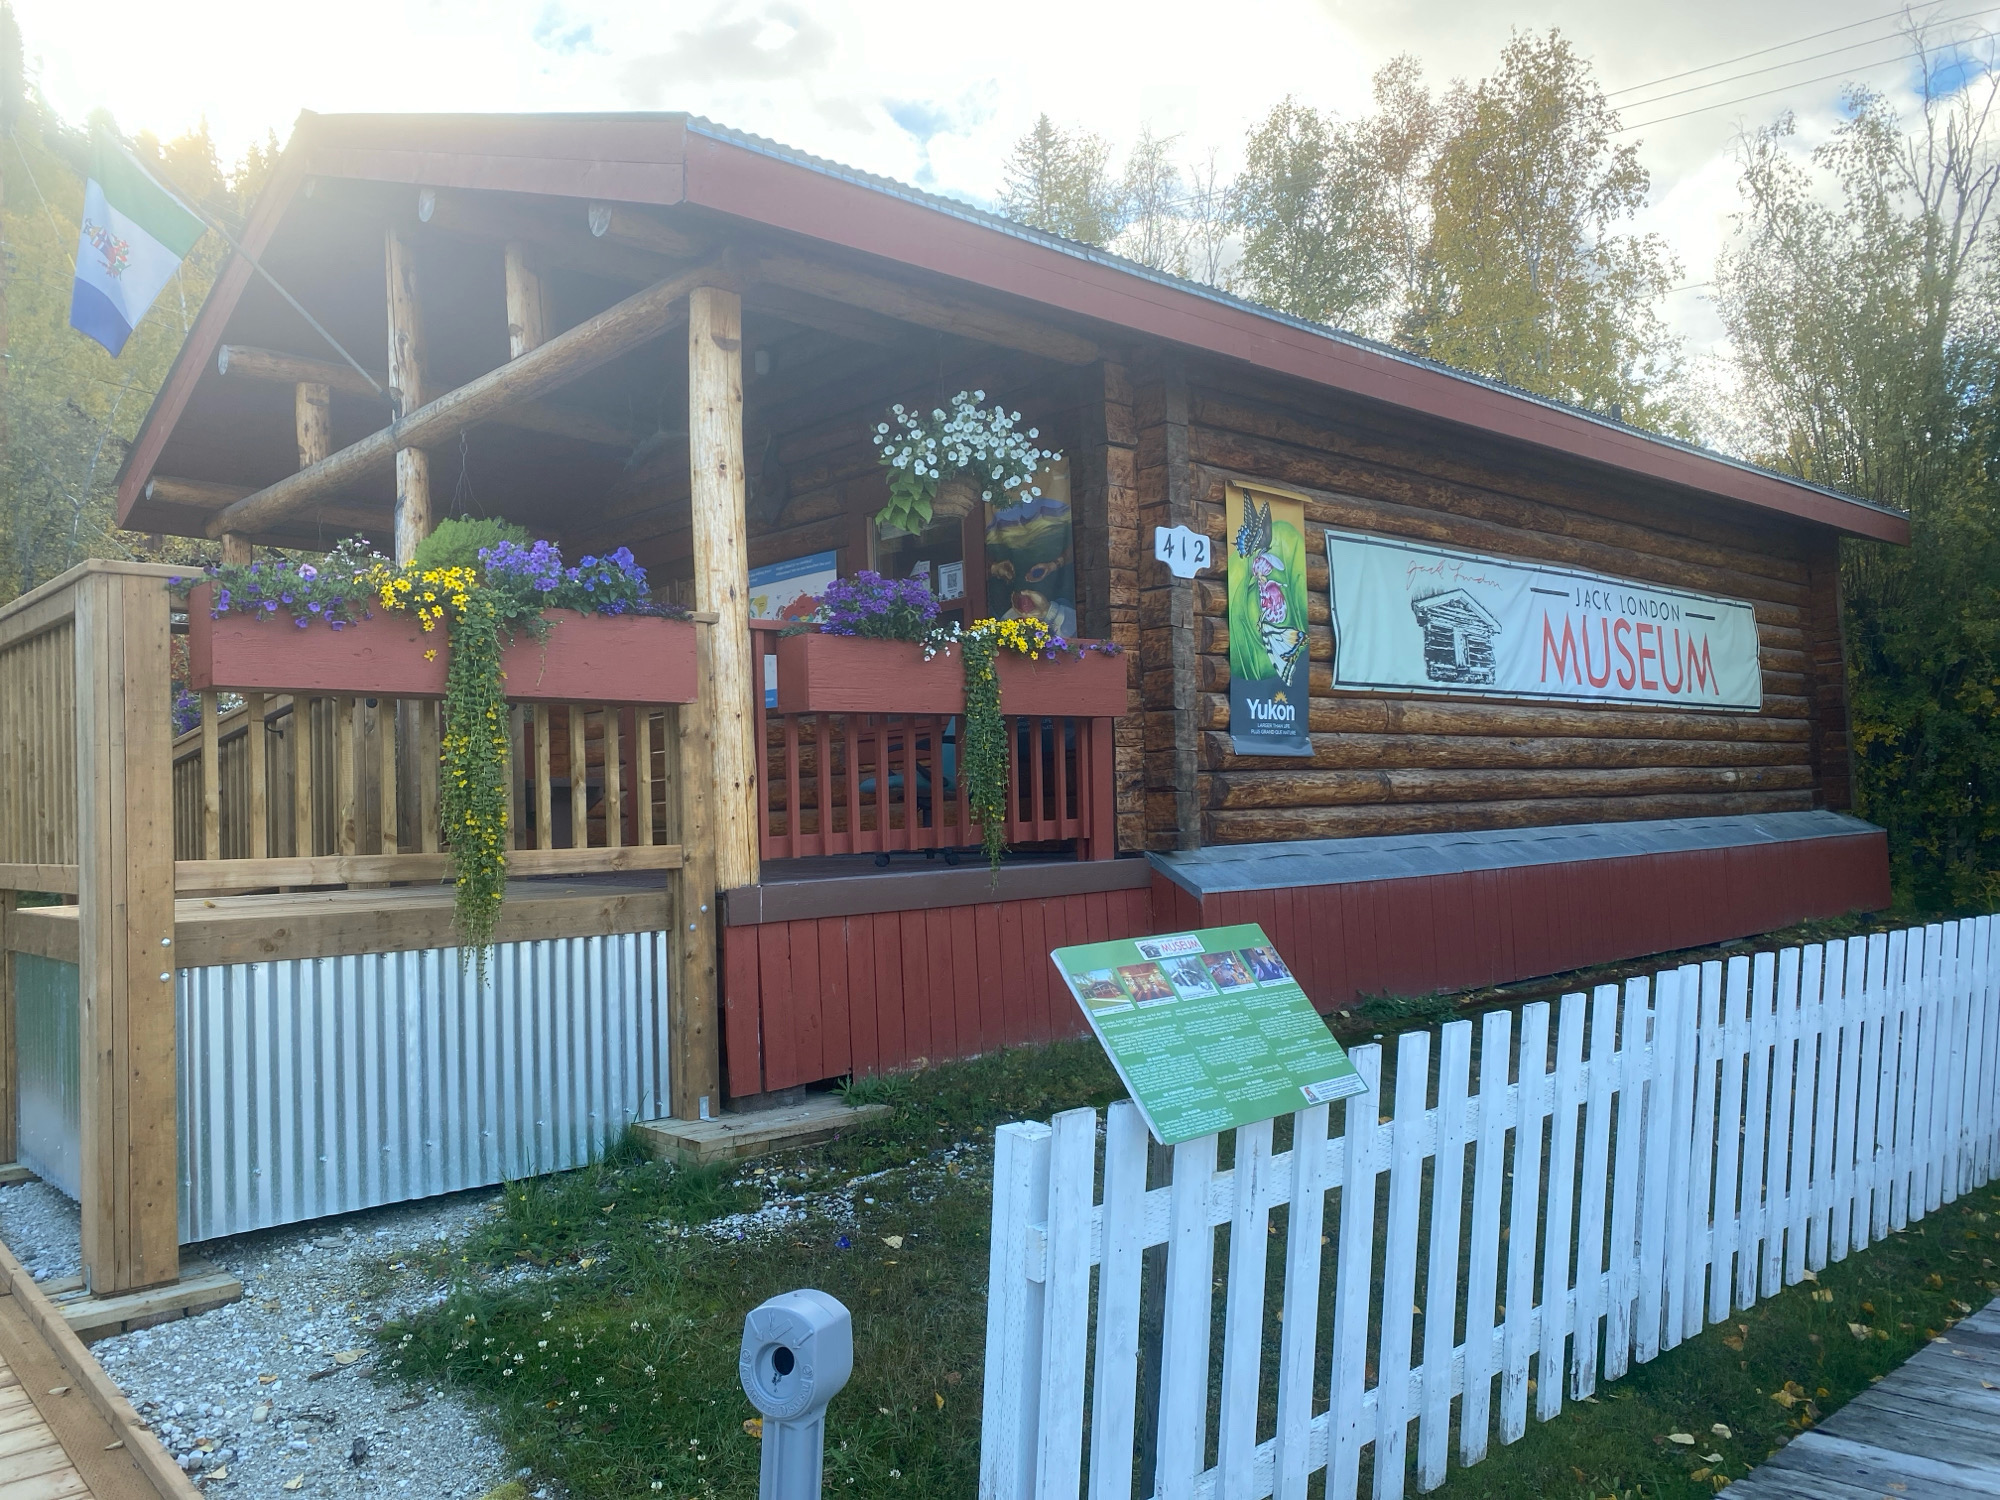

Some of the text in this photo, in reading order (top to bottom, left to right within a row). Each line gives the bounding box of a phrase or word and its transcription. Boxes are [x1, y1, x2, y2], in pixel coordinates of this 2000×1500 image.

[1163, 533, 1205, 563] 412
[1575, 587, 1681, 622] JACK LONDON
[1540, 607, 1720, 696] MUSEUM
[1246, 698, 1296, 721] Yukon
[1161, 938, 1200, 952] MUSEUM
